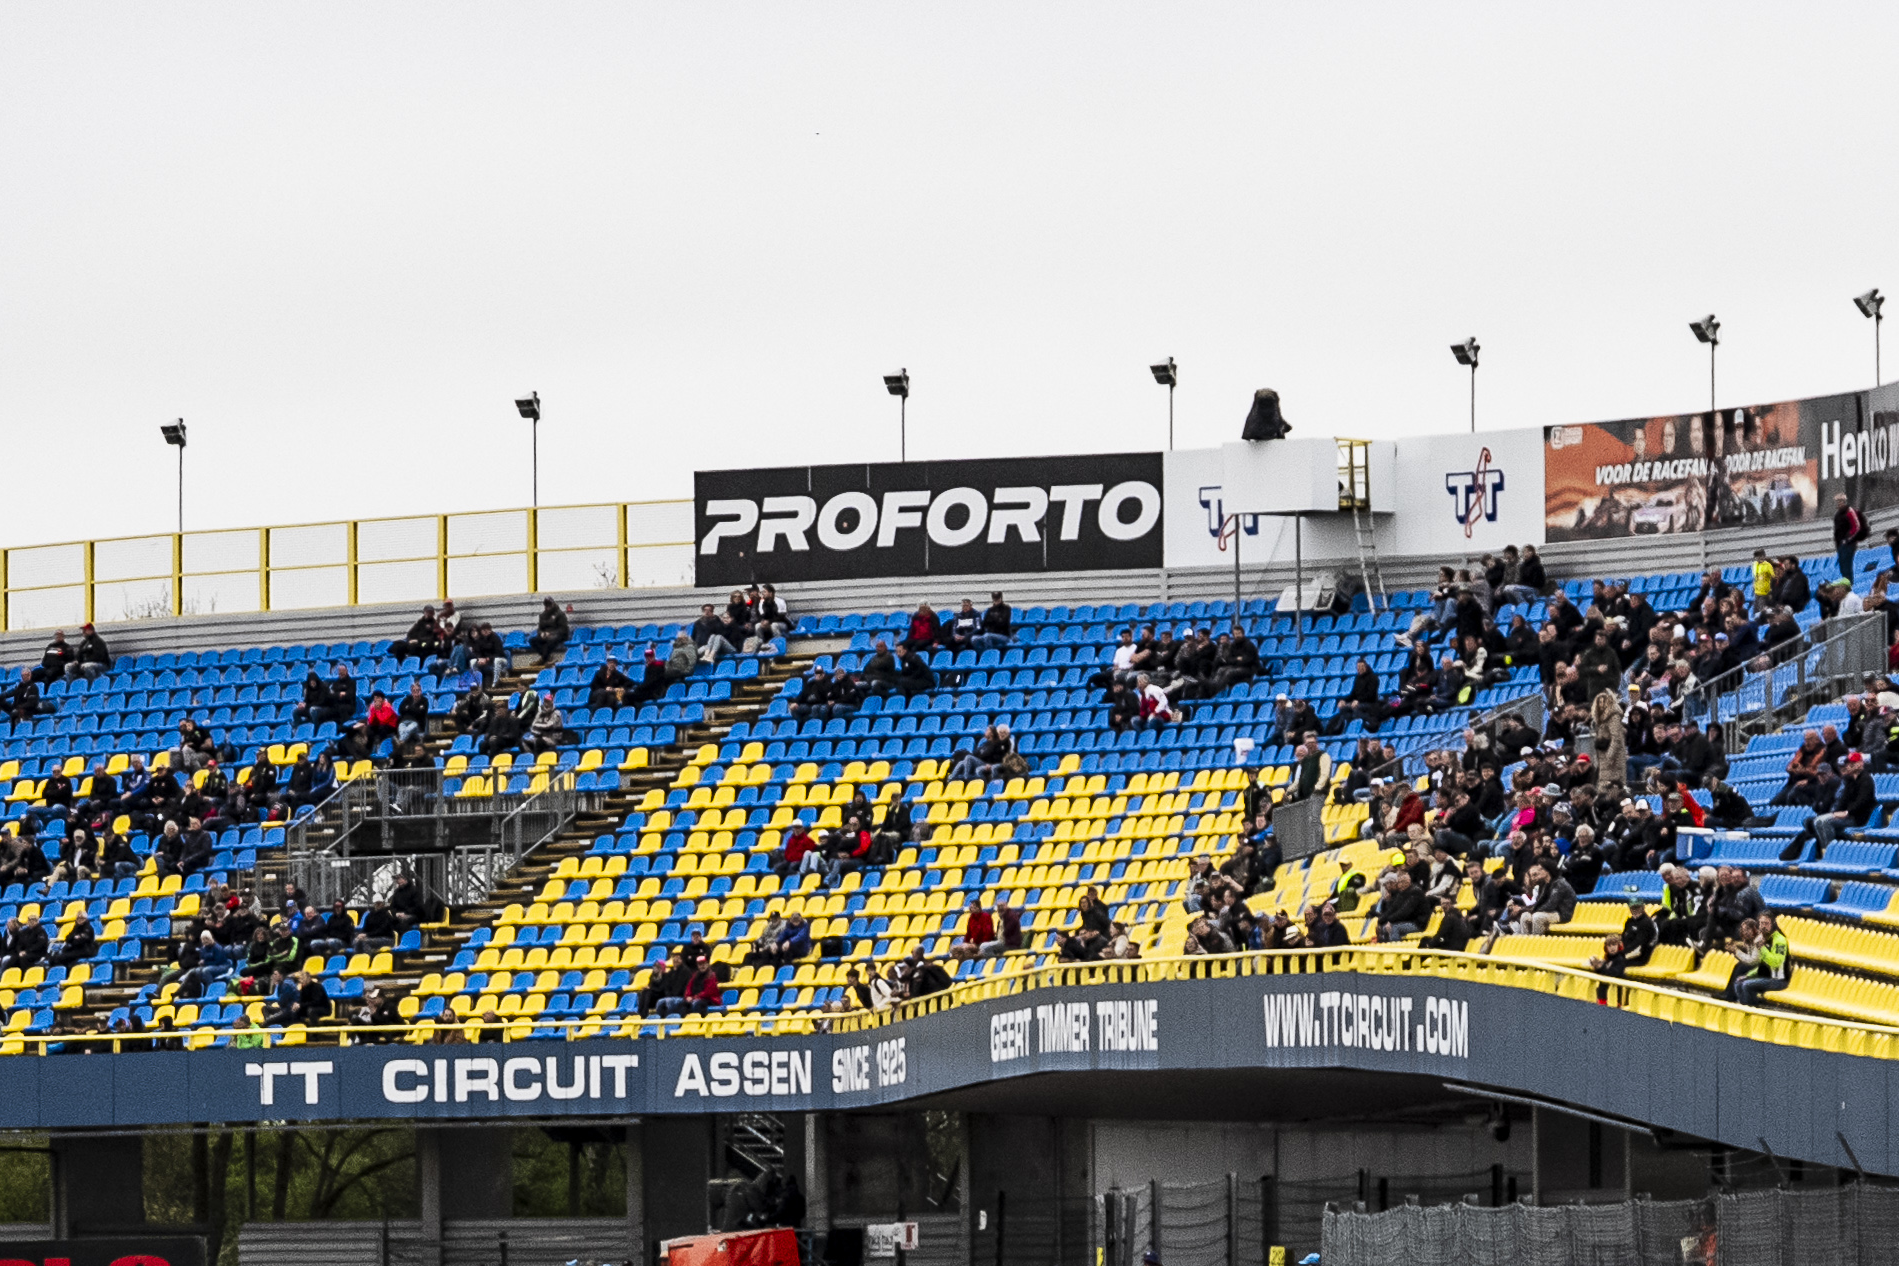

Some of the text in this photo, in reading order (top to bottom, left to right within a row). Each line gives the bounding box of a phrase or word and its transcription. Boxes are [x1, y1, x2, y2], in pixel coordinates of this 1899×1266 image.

[1595, 463, 1632, 486] VOOR
[1632, 461, 1652, 482] DE
[700, 480, 1161, 556] PROFORTO
[990, 999, 1159, 1062] GEERT TIMMER TRIBUNE
[245, 1036, 907, 1105] TT CIRCUIT ASSEN SINCE 1925
